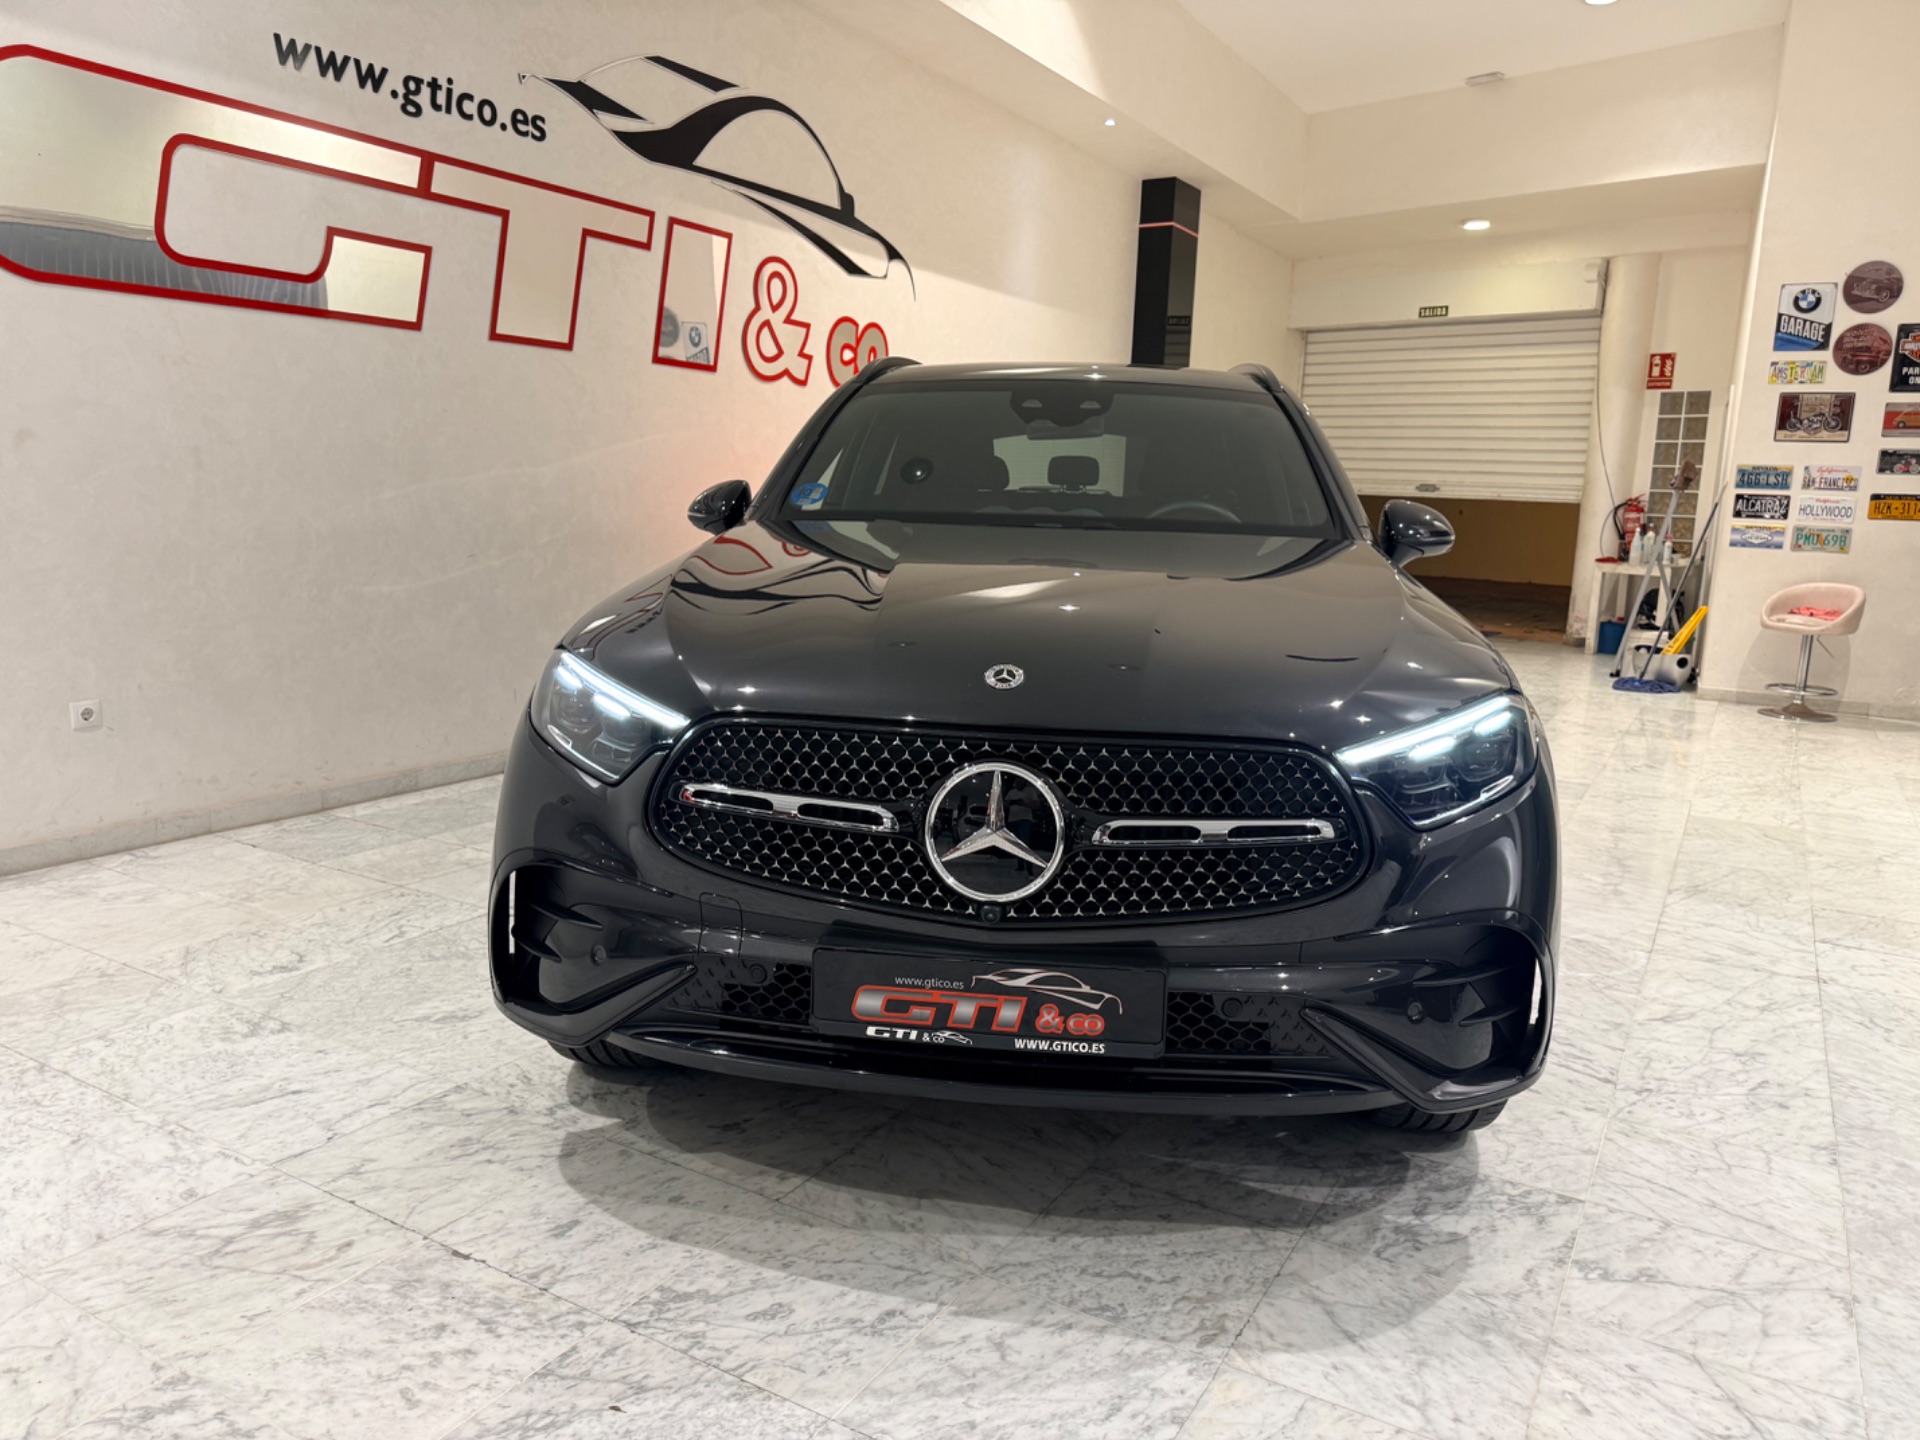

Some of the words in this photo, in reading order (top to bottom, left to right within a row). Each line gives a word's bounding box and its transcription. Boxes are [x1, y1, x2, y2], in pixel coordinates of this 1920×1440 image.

[273, 32, 547, 142] www.gtico.es
[0, 44, 733, 373] GTI
[741, 256, 814, 387] &
[1780, 315, 1826, 342] GARAGE
[1735, 498, 1788, 514] ALCATRAZ
[1798, 504, 1853, 518] HOLLYWOOD
[894, 976, 965, 990] www.gtico.es
[851, 985, 1028, 1033] GTI
[866, 1025, 918, 1041] GTI
[1014, 1038, 1106, 1054] WWW.GTICO.ES
